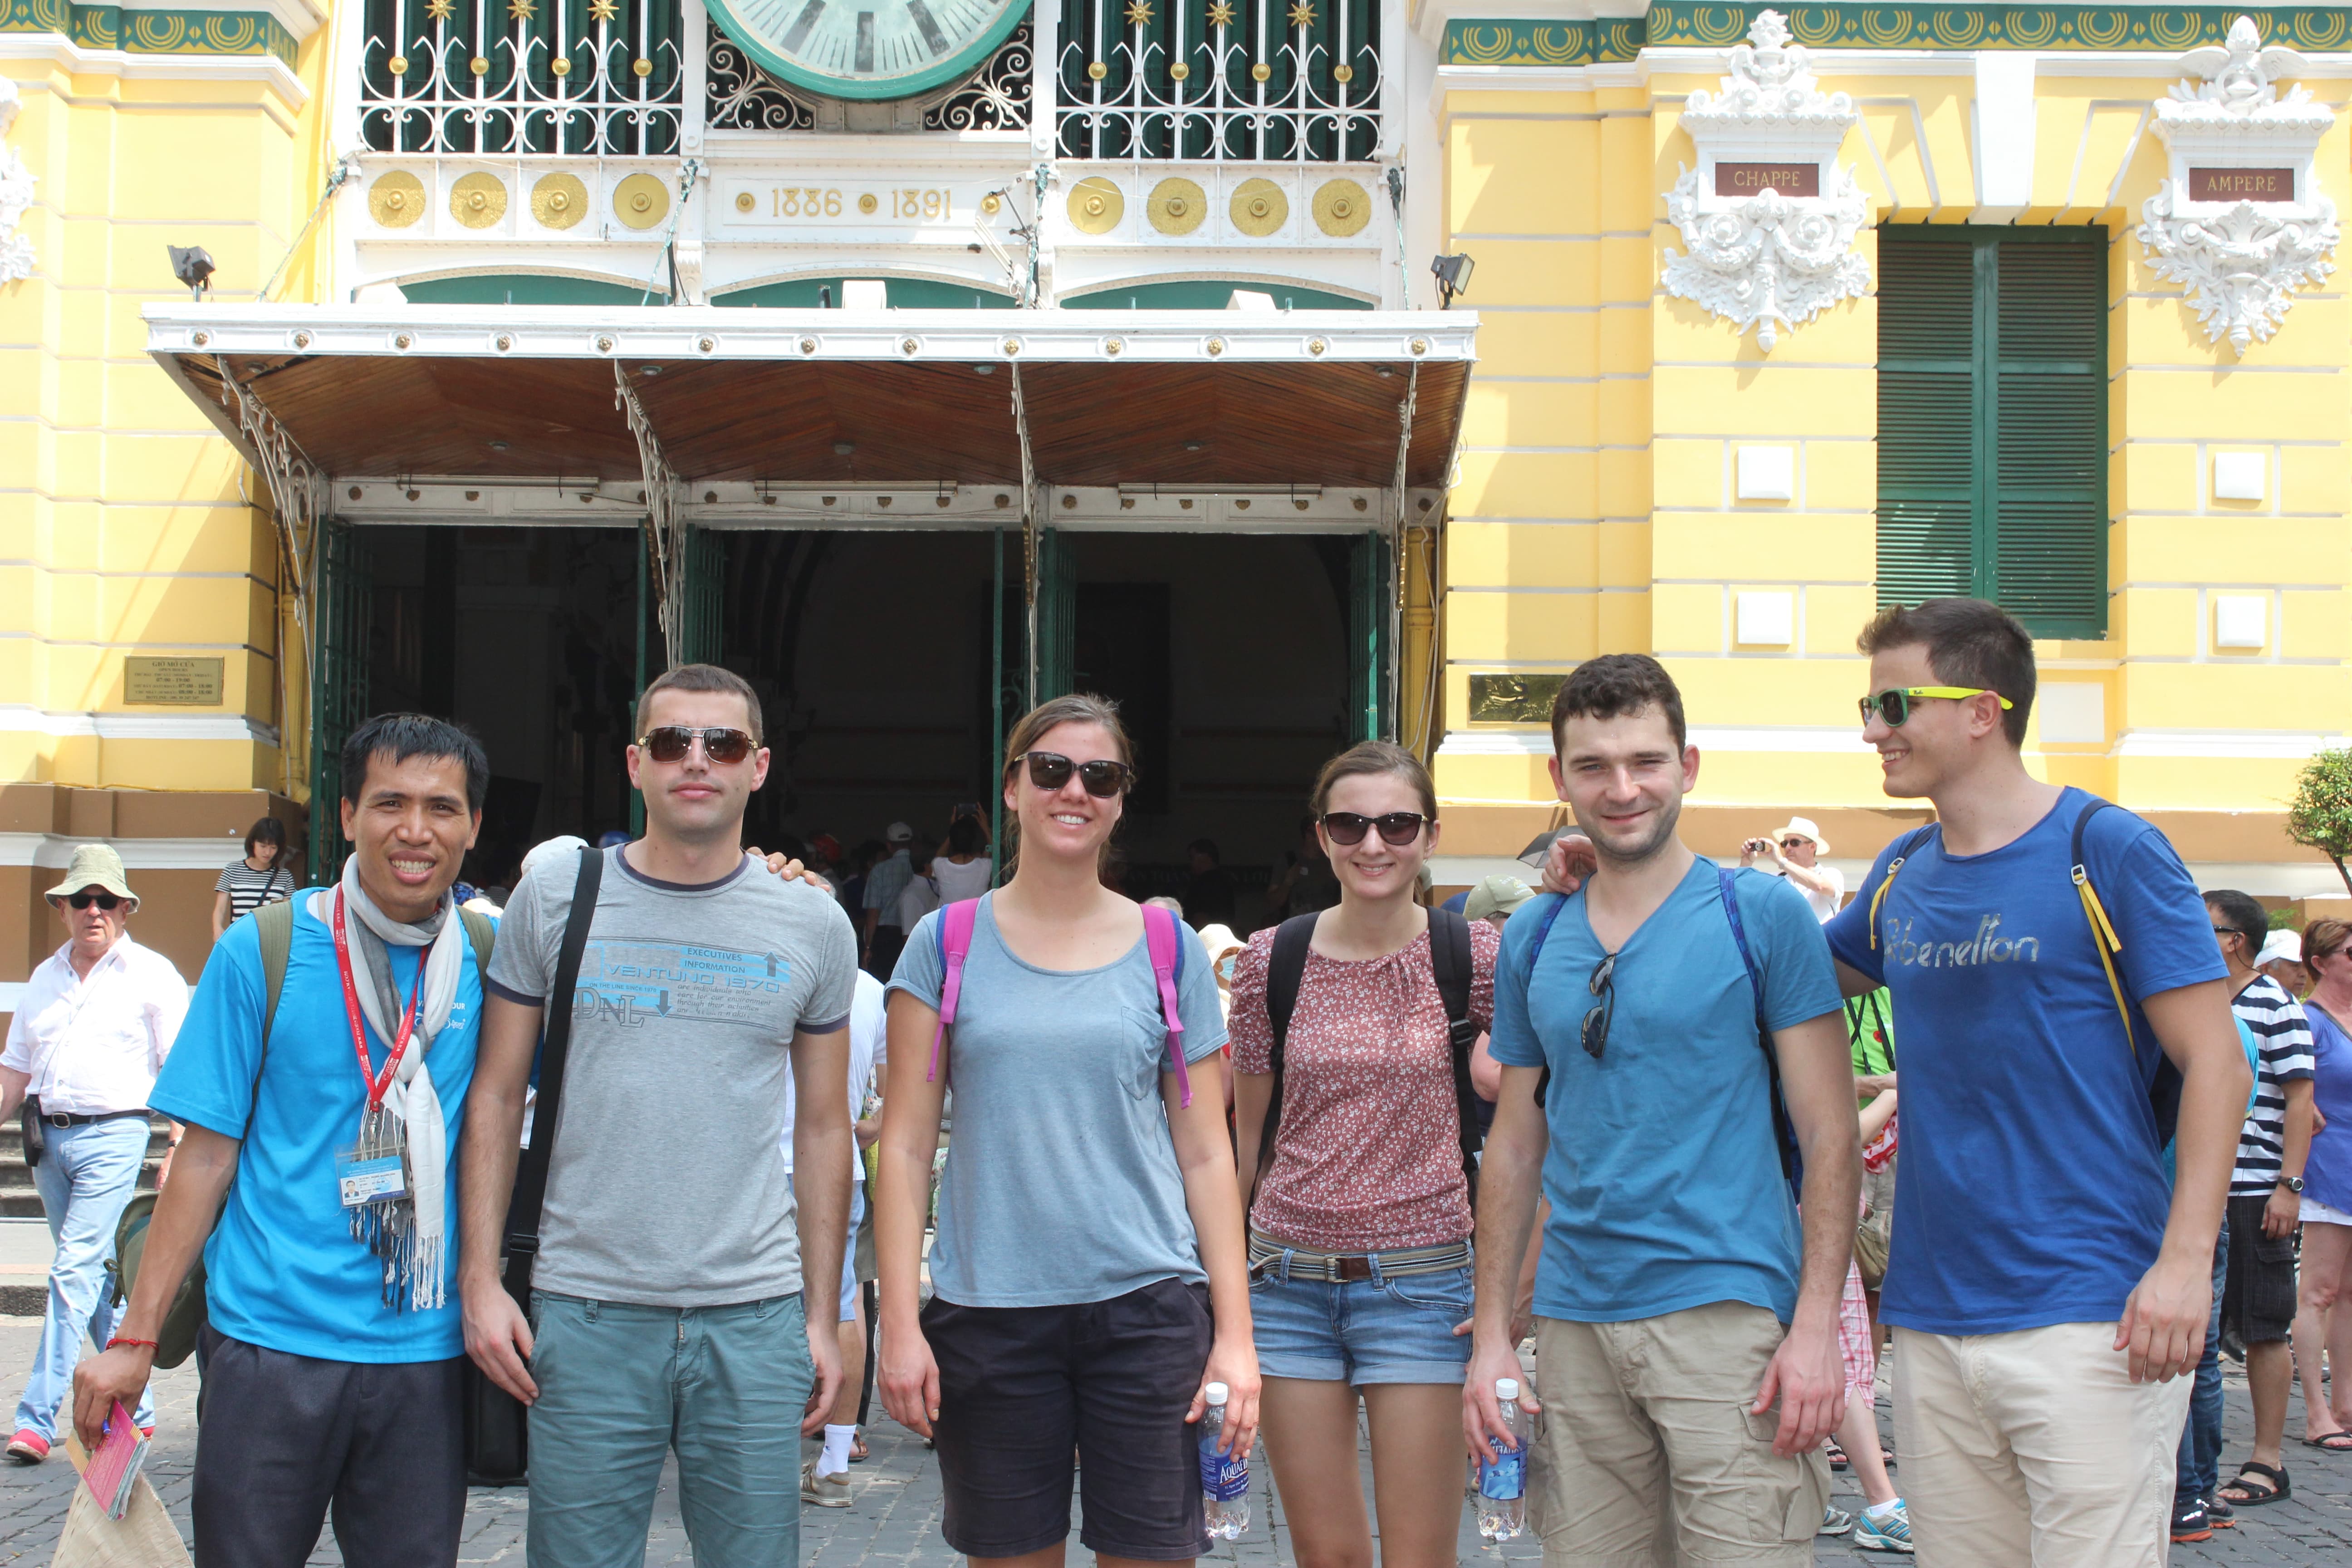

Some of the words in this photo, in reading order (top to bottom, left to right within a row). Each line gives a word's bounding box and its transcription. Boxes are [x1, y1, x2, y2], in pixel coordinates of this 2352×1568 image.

[1735, 171, 1800, 186] CHAPPE
[2207, 176, 2276, 191] AMPERE
[772, 188, 843, 217] 1886
[892, 189, 951, 218] 1891
[688, 948, 742, 961] EXECUTIVES
[684, 960, 745, 974] INFORMATION
[607, 964, 714, 985] VENTUNO
[725, 976, 780, 993] 1970
[694, 985, 732, 994] individuals
[677, 998, 705, 1008] through
[697, 991, 708, 1000] for
[727, 997, 771, 1006] environment
